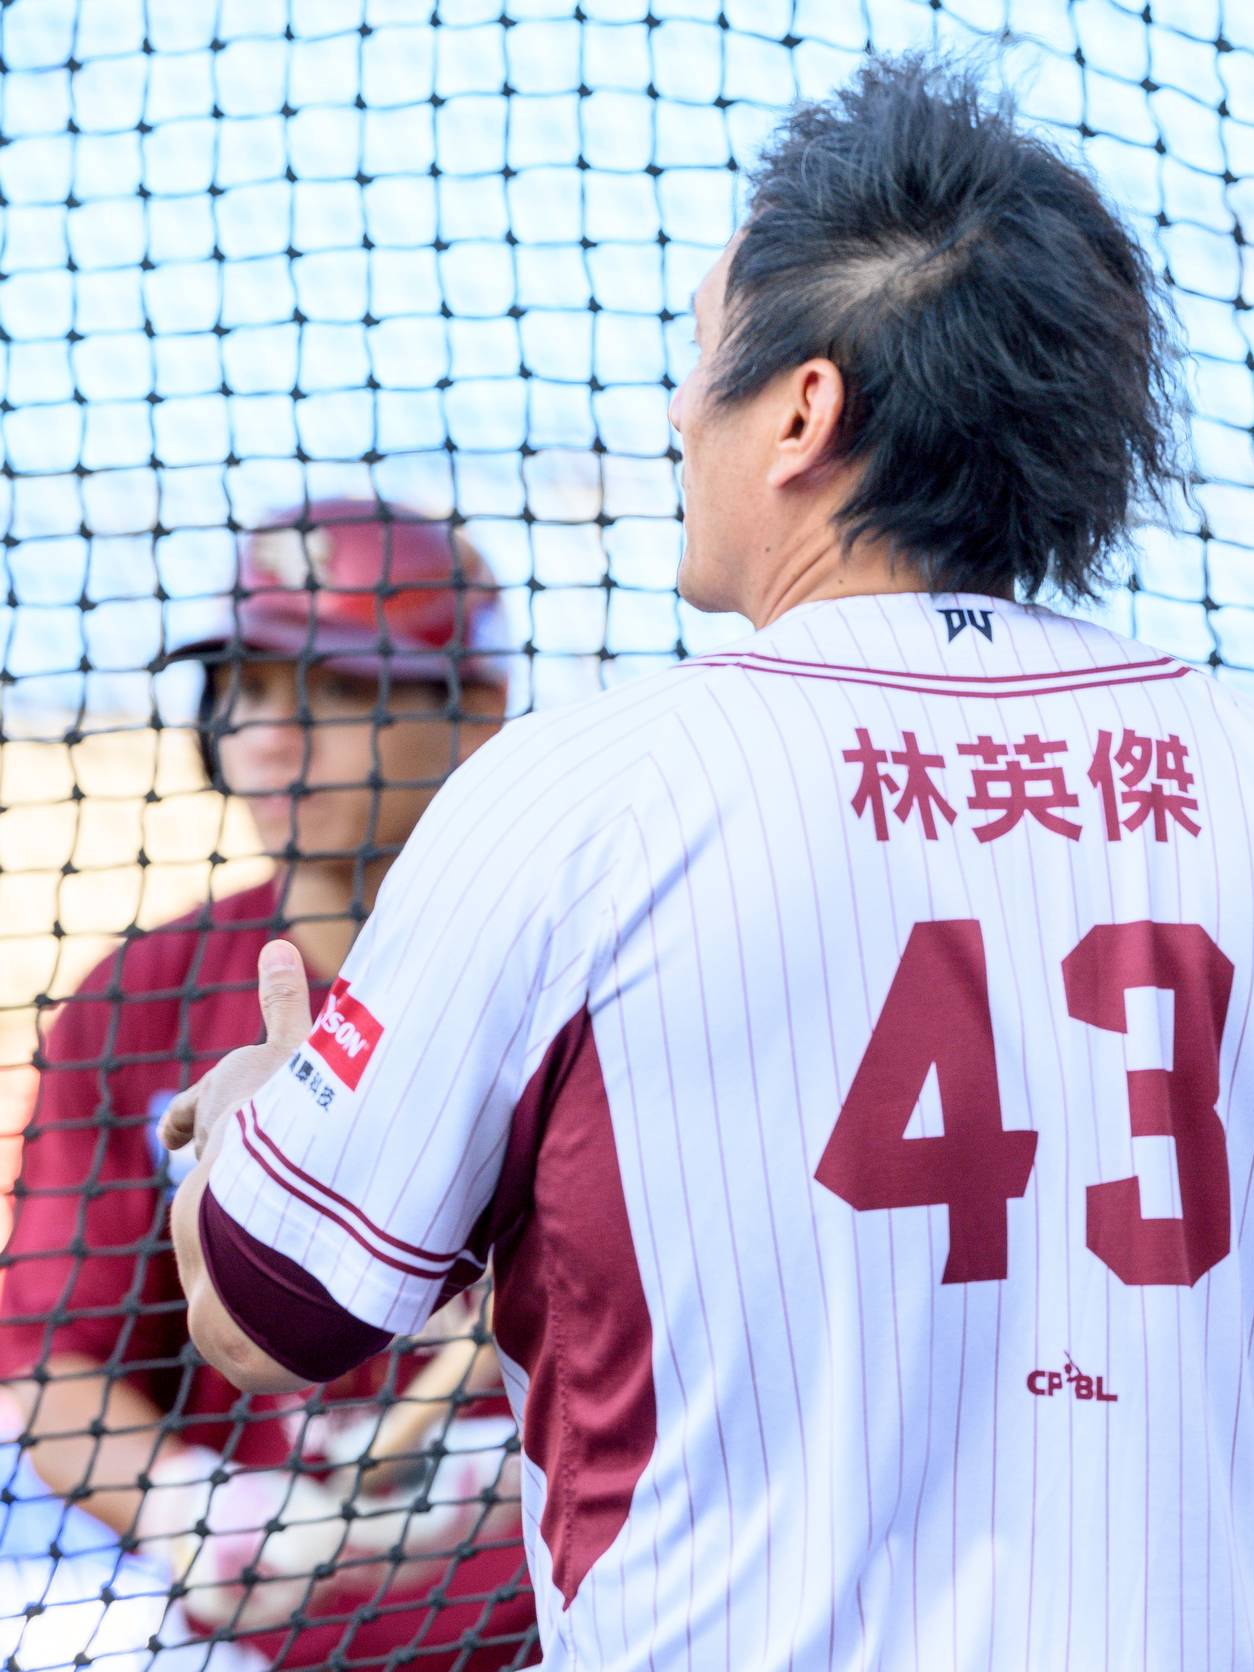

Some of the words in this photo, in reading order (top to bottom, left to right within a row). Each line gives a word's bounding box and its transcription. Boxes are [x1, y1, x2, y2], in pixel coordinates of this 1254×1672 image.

[841, 727, 1203, 844] 林英傑
[813, 918, 1236, 1289] 43
[1026, 1369, 1118, 1402] CPBL
